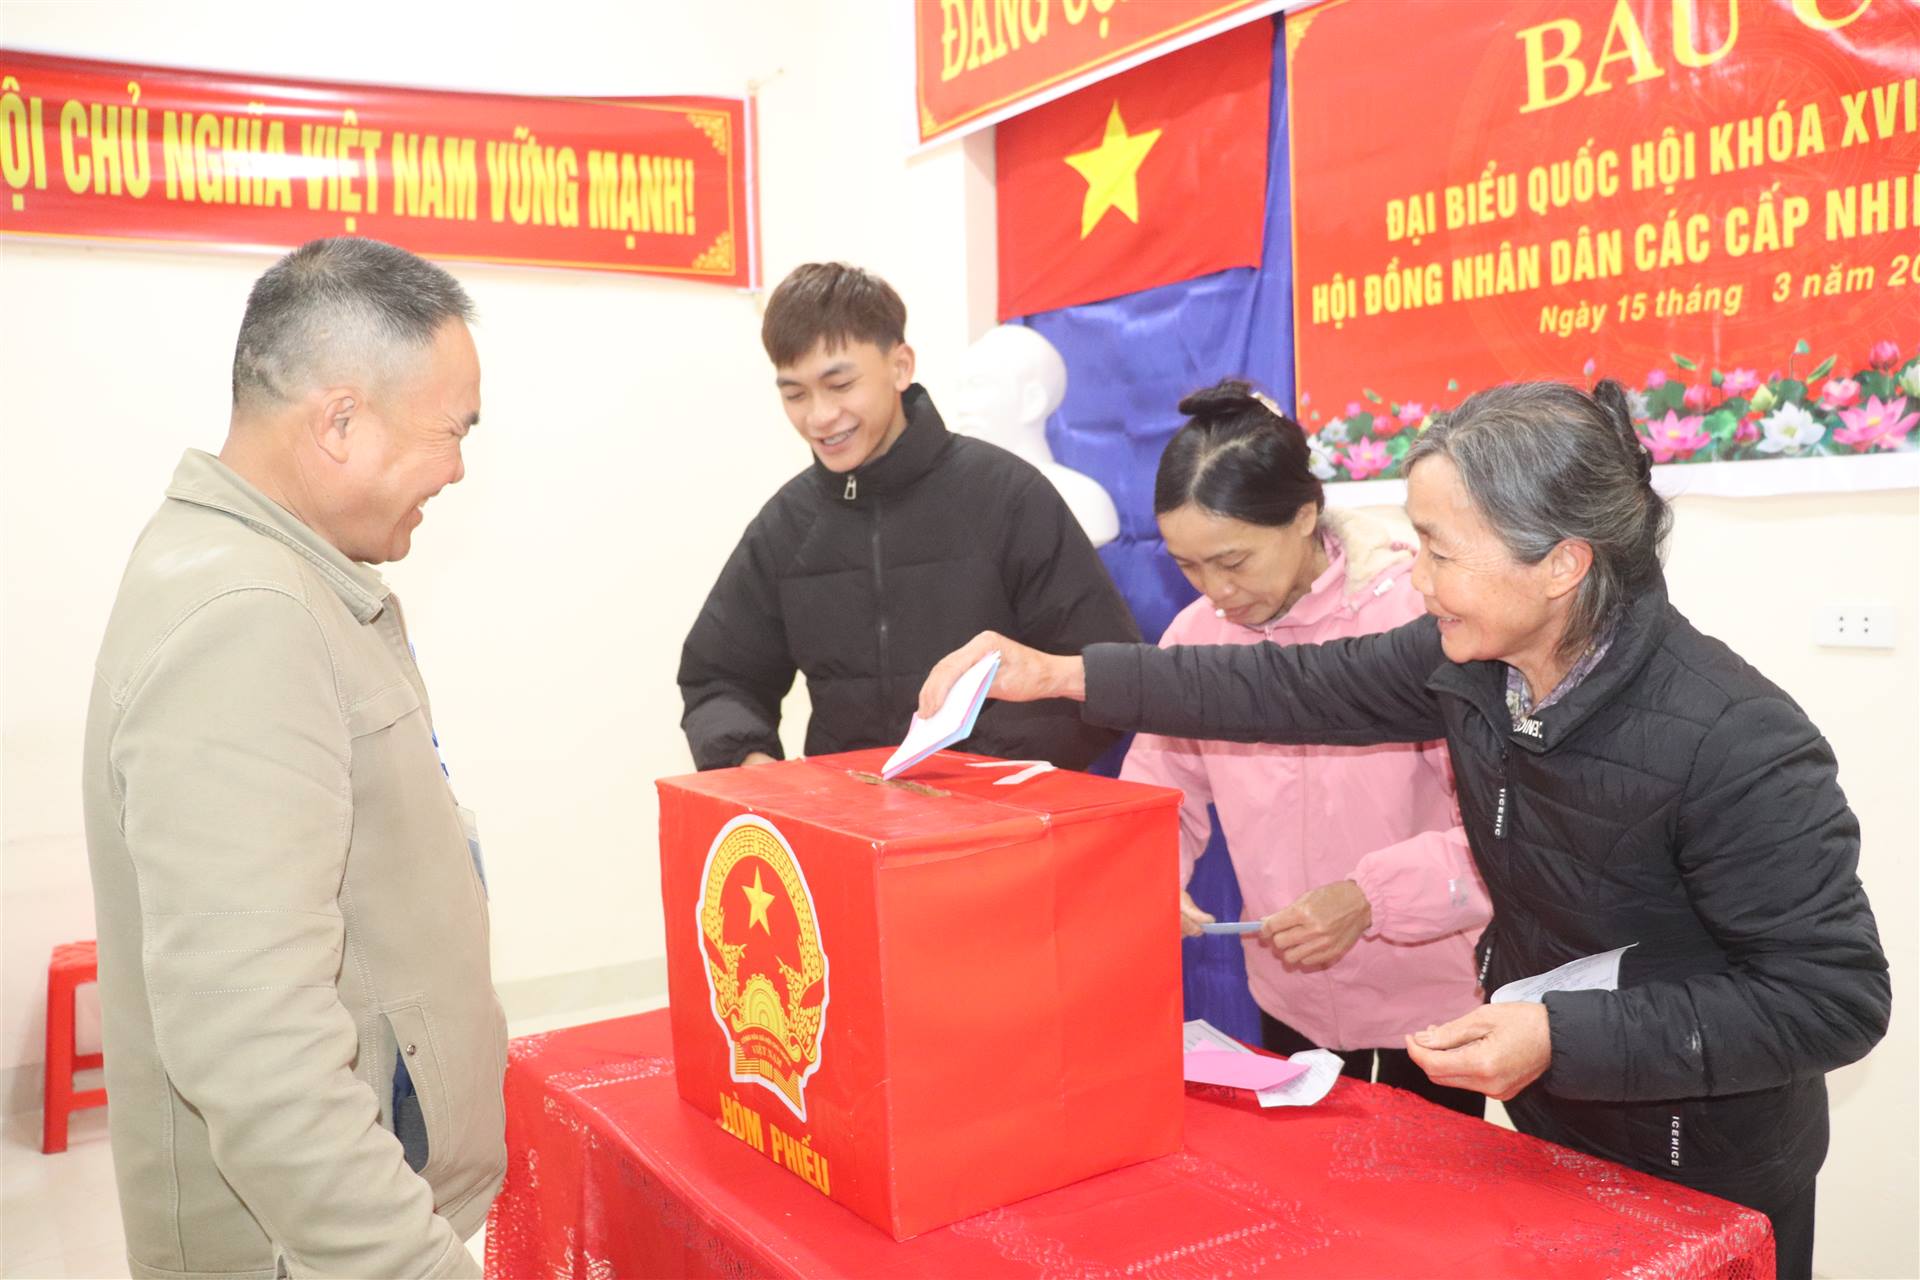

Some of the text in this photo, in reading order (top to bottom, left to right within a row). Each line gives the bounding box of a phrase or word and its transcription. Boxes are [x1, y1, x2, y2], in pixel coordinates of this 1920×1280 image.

[60, 81, 151, 199] CHỦ
[163, 102, 292, 208] NGHĨA
[302, 109, 382, 232] VIỆT
[392, 132, 477, 220] NAM
[486, 126, 579, 227] VỮNG
[588, 150, 695, 250] MẠNH!
[1386, 78, 1918, 246] ĐẠI BIỂU QUỐC HỘI KHÓA XVI
[1312, 272, 1356, 329] HỘI
[1452, 241, 1540, 301] NHÂN
[1550, 226, 1622, 286] DÂN
[1634, 208, 1710, 272] CÁC
[1725, 181, 1809, 257] CẤP
[1539, 300, 1608, 338] Ngày
[1617, 292, 1647, 323] 15
[1655, 283, 1743, 316] tháng
[1772, 271, 1791, 302] 3
[1802, 262, 1875, 298] năm
[720, 1091, 830, 1196] HÒM PHIẾU
